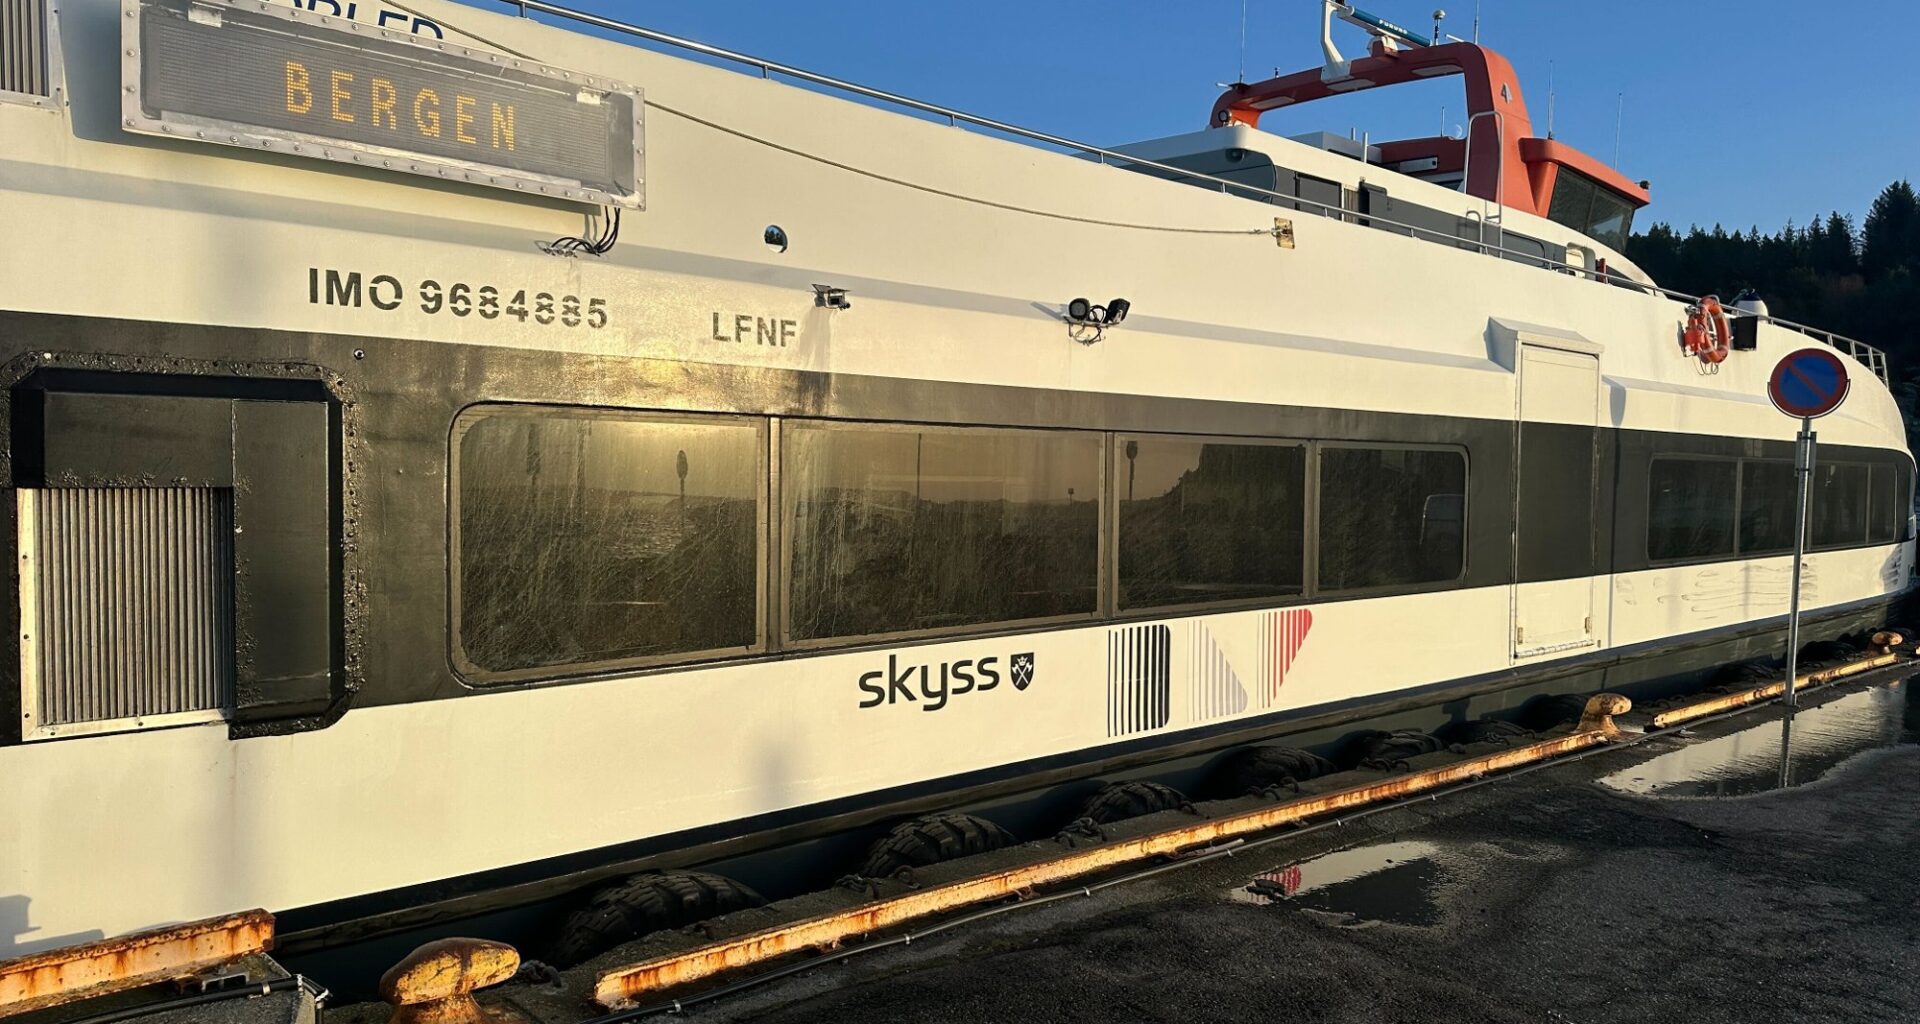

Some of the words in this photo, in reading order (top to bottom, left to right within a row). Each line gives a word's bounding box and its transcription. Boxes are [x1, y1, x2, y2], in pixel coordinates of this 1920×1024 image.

[286, 61, 514, 151] BERGEN
[308, 267, 403, 311] IMO
[419, 279, 608, 329] 9684885
[712, 311, 797, 348] LFNF
[858, 653, 1000, 712] skyss
